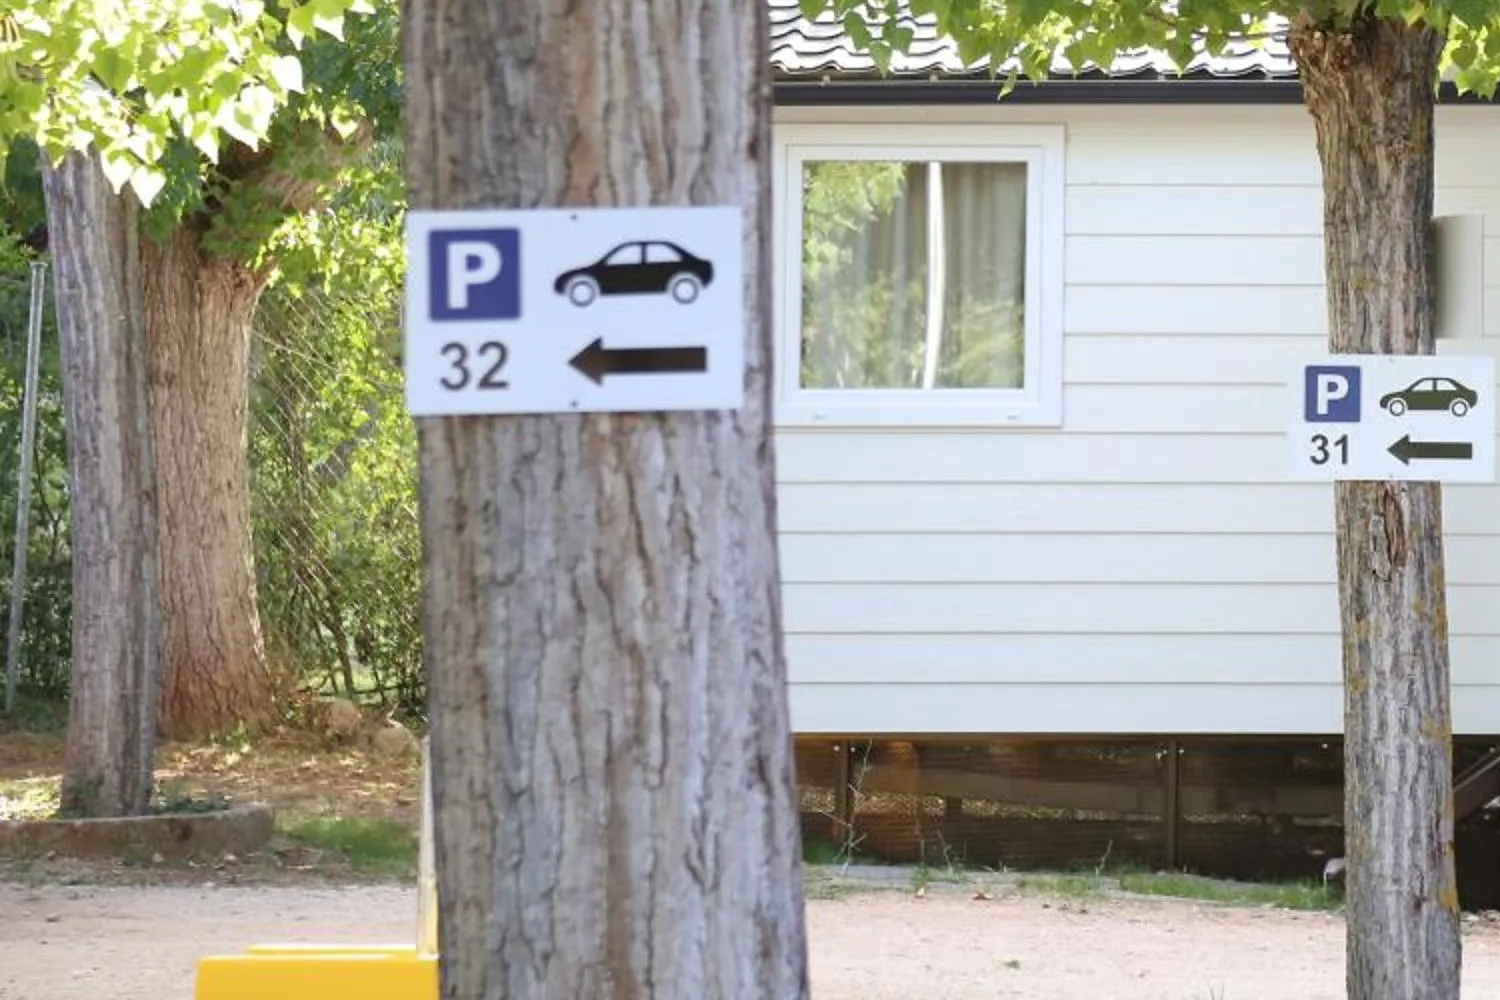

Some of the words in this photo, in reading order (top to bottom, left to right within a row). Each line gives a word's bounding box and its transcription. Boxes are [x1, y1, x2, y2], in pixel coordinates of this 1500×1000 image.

[447, 241, 502, 310] P
[439, 340, 509, 391] 32
[1316, 373, 1349, 415] P
[1310, 433, 1348, 465] 31
